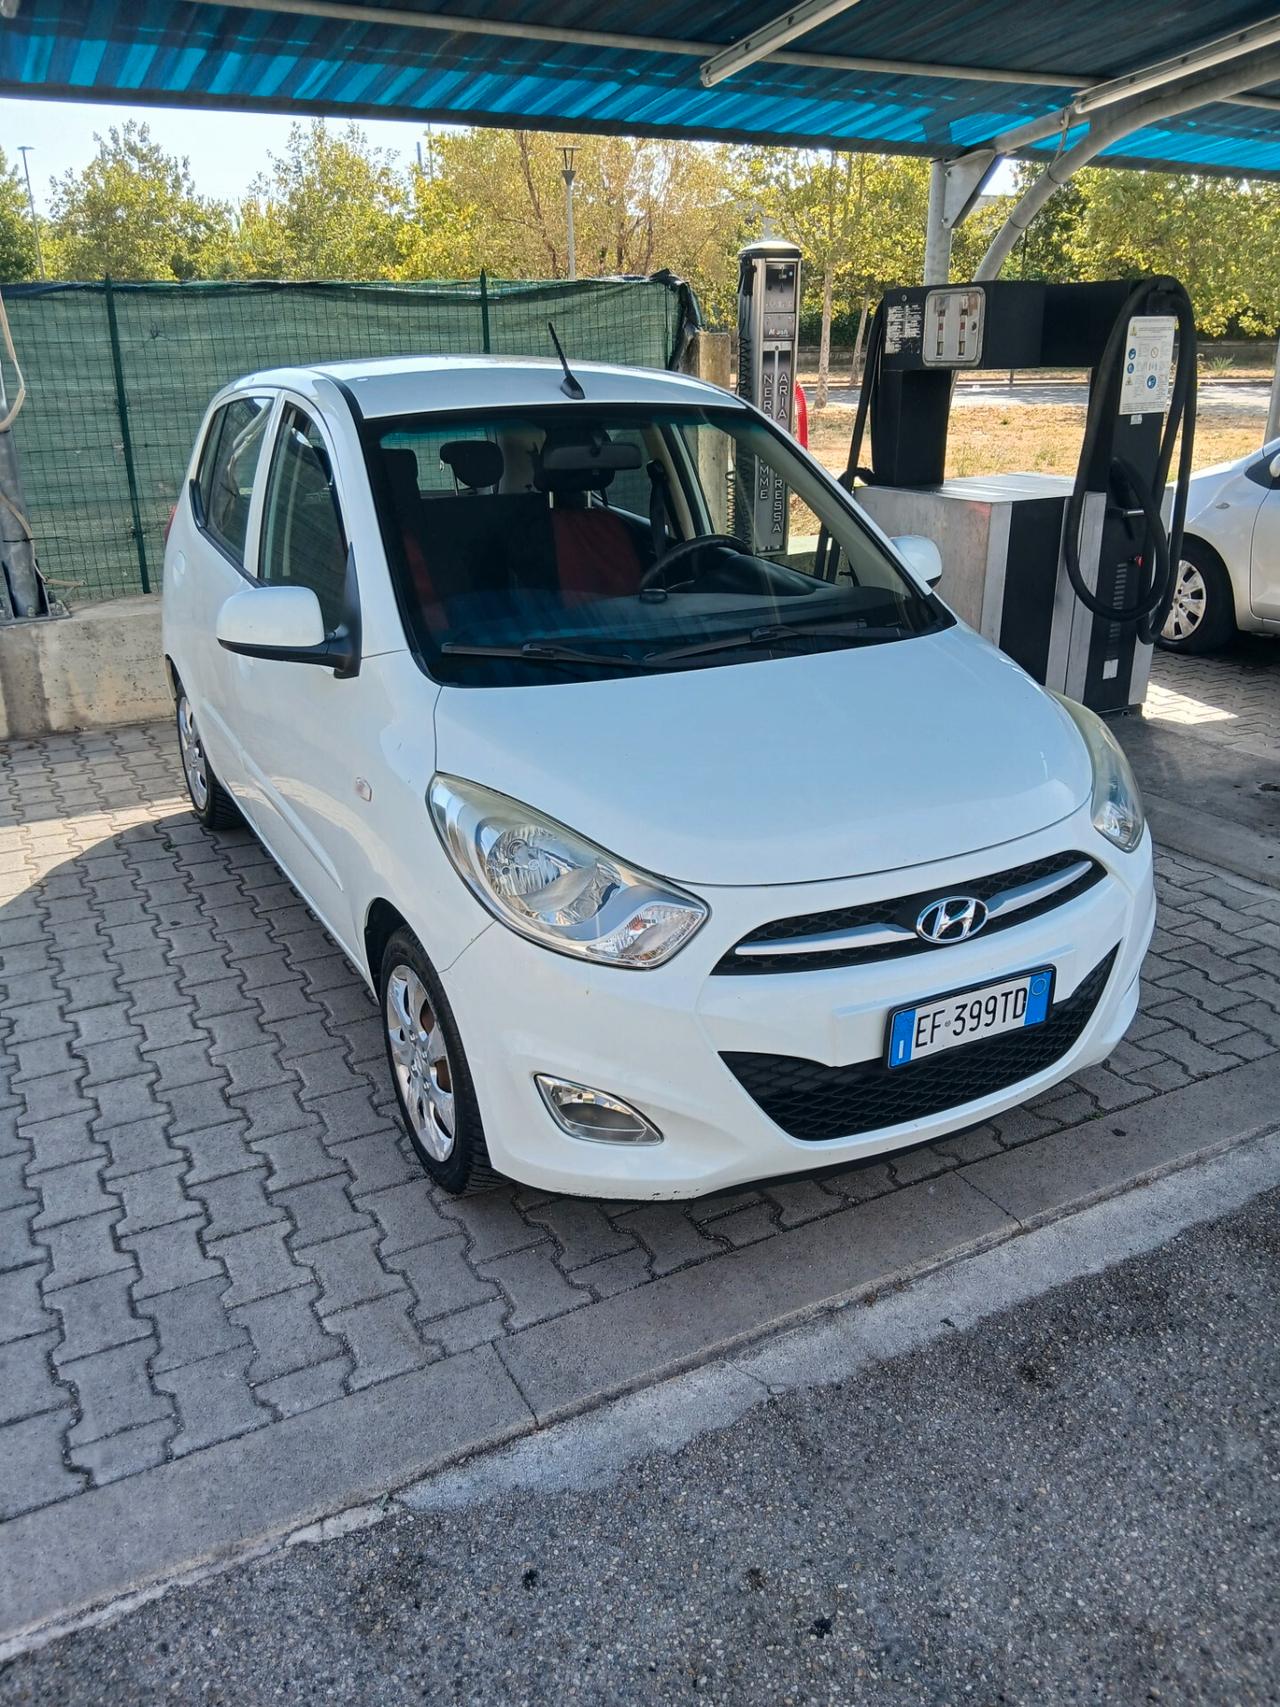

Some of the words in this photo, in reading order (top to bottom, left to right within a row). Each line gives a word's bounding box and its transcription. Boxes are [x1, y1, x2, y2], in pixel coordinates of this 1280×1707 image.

[778, 374, 788, 419] ARIA
[914, 1009, 946, 1049] EF
[952, 987, 1028, 1037] 399TD
